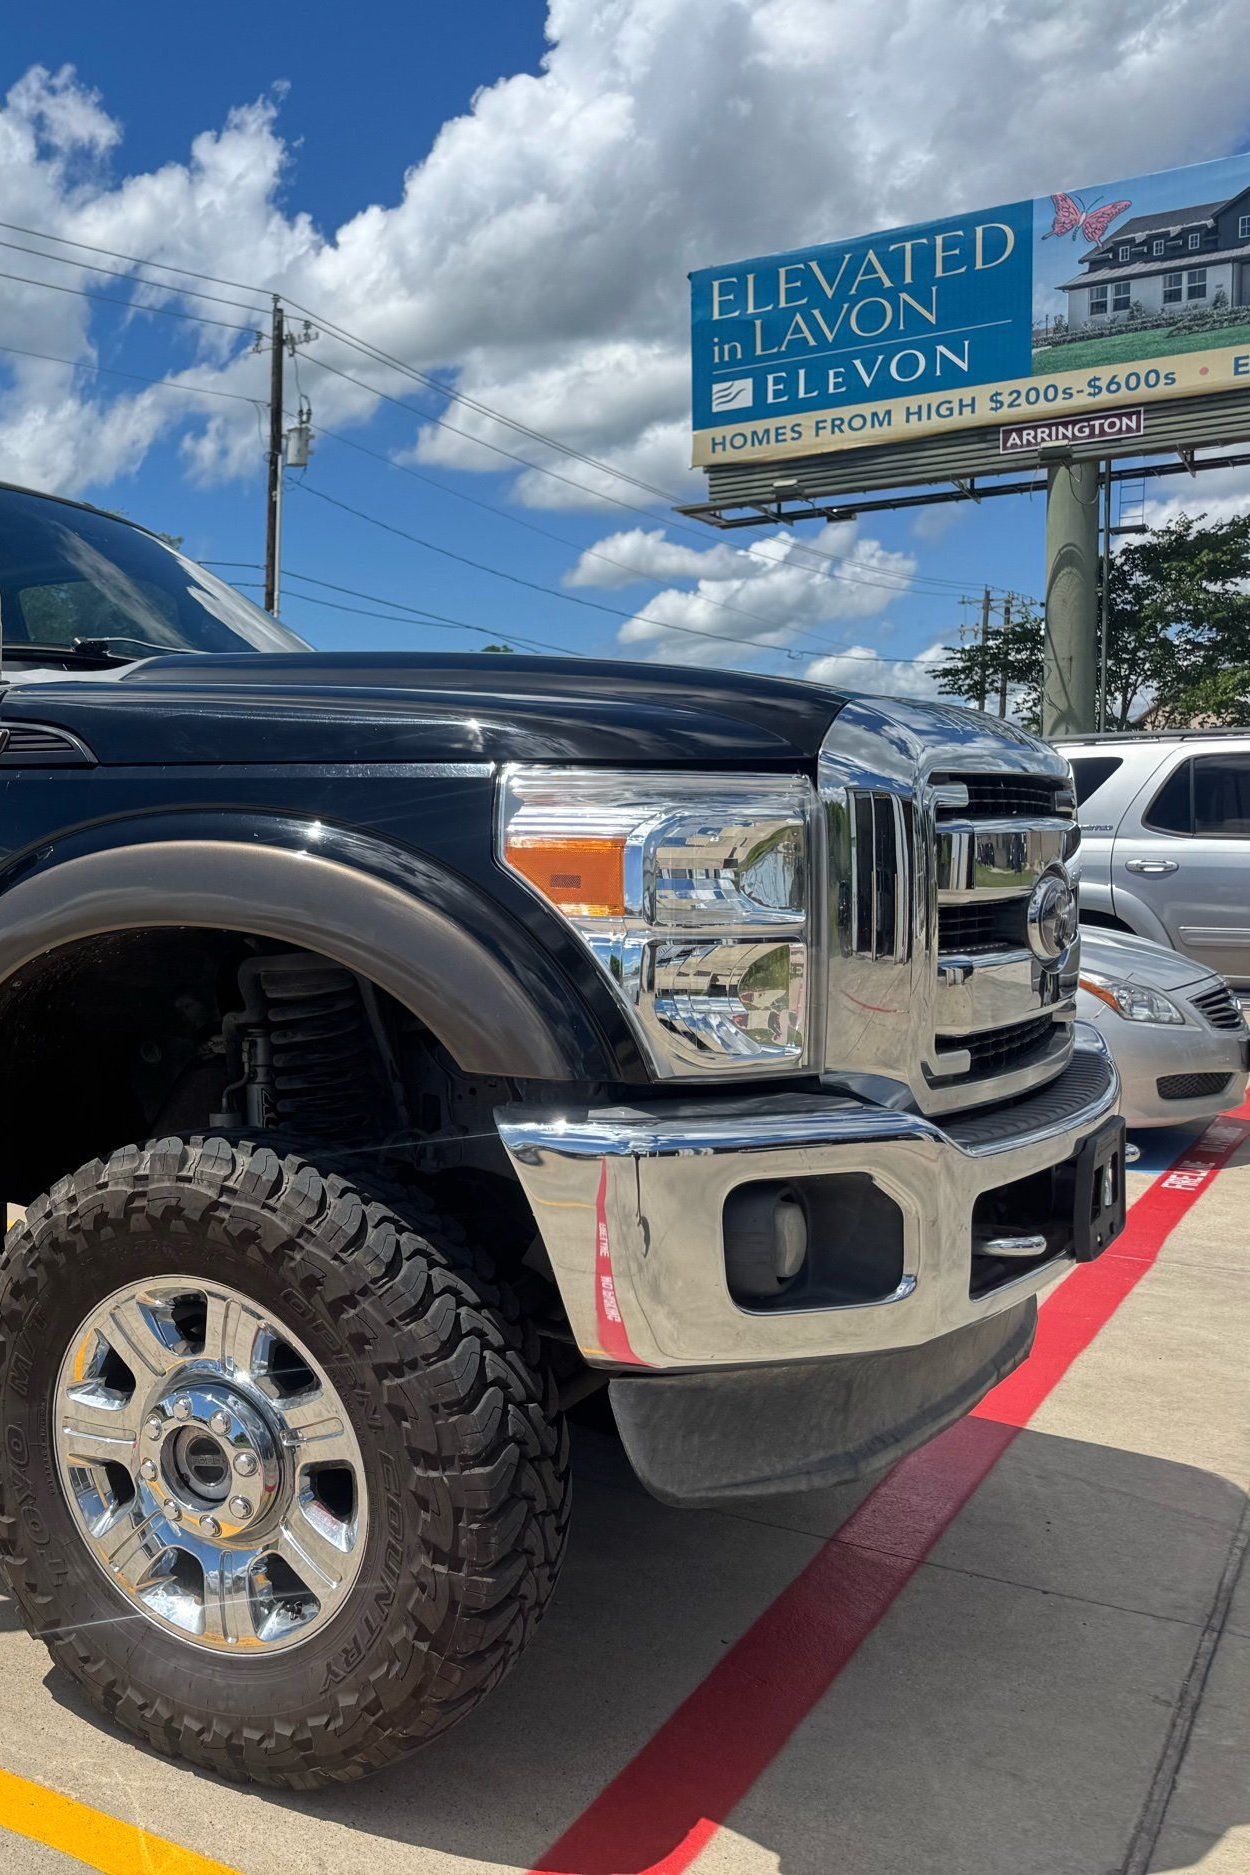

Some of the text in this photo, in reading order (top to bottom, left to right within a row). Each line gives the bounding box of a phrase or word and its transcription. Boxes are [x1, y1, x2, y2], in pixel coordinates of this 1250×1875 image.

[711, 223, 1015, 320] ELEVATED
[712, 286, 937, 363] in LAVON
[711, 423, 803, 454] HOMES
[814, 409, 892, 438] FROM
[904, 396, 976, 424] HIGH
[988, 368, 1177, 412] $200s-$600s
[766, 339, 970, 404] ELEVON
[1006, 414, 1137, 448] ARRINGTON
[280, 1287, 404, 1695] OPEN COUNTRY
